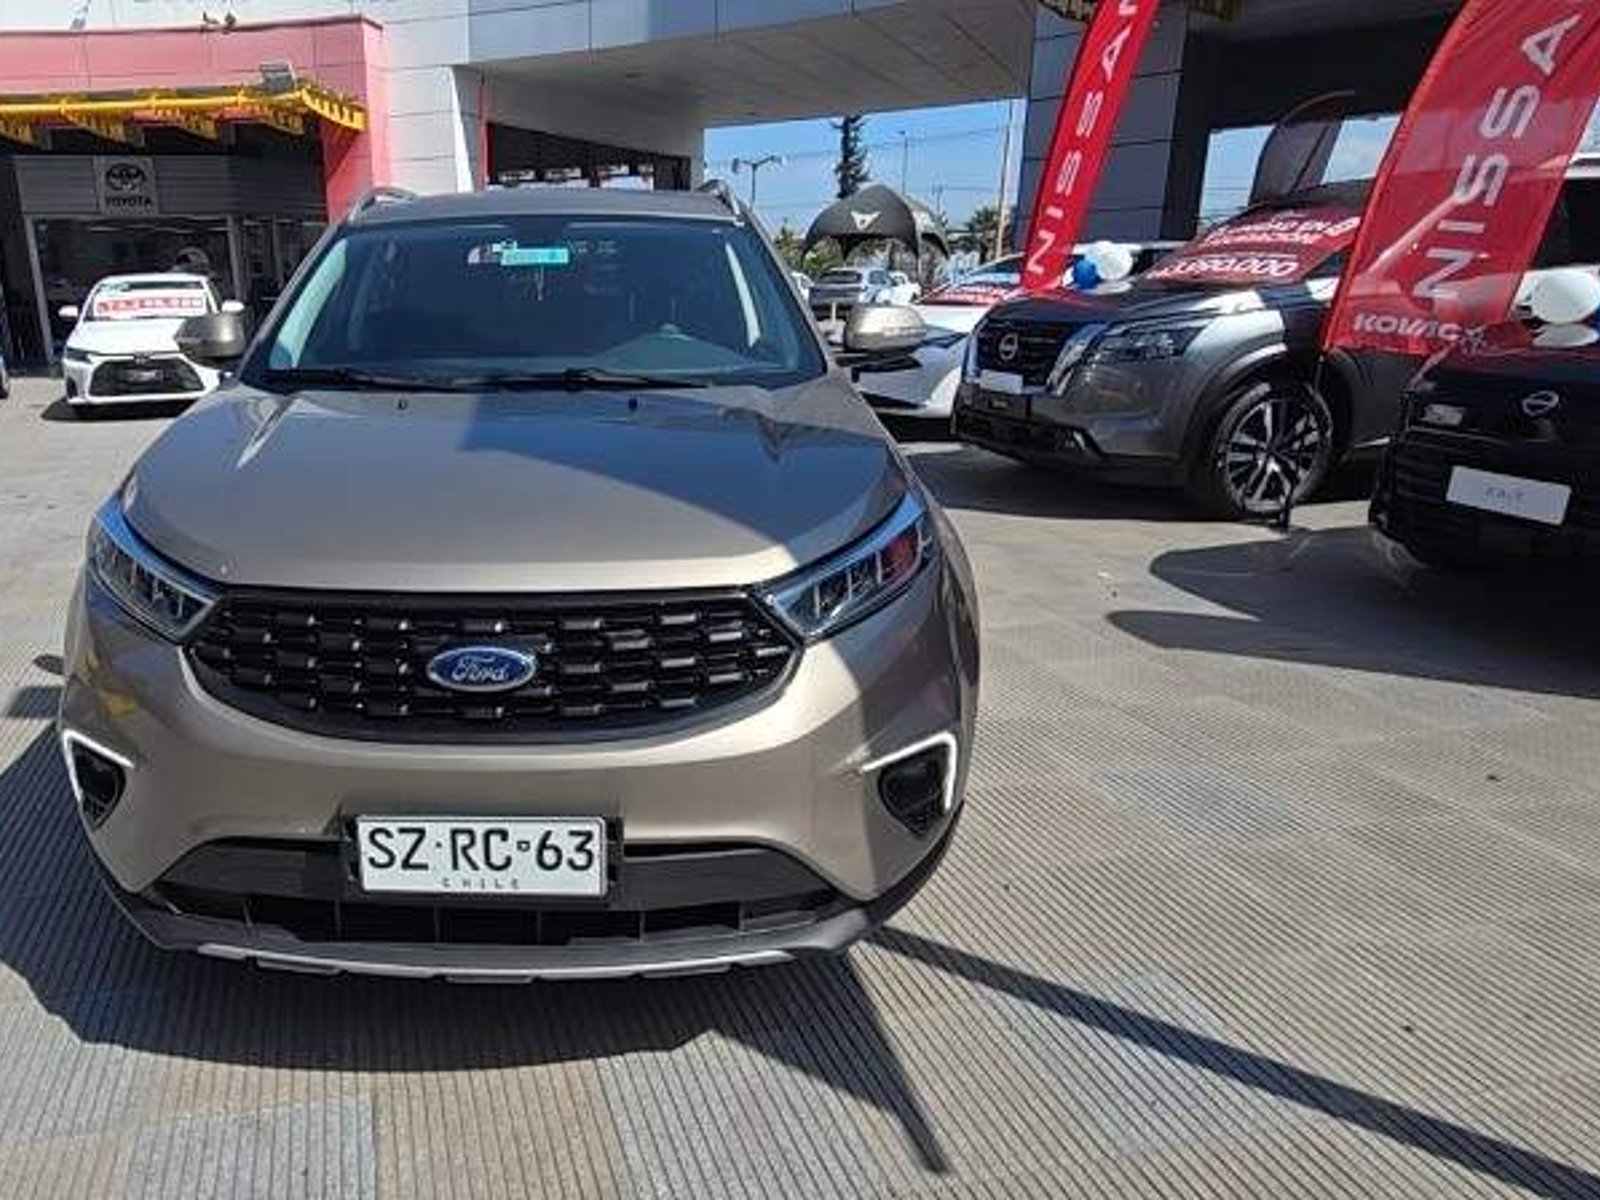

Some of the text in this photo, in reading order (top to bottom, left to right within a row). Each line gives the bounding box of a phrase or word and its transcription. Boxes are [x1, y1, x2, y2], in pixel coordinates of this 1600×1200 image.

[105, 196, 153, 209] TOYOTA
[451, 655, 509, 681] Ford
[442, 878, 520, 889] CHILE
